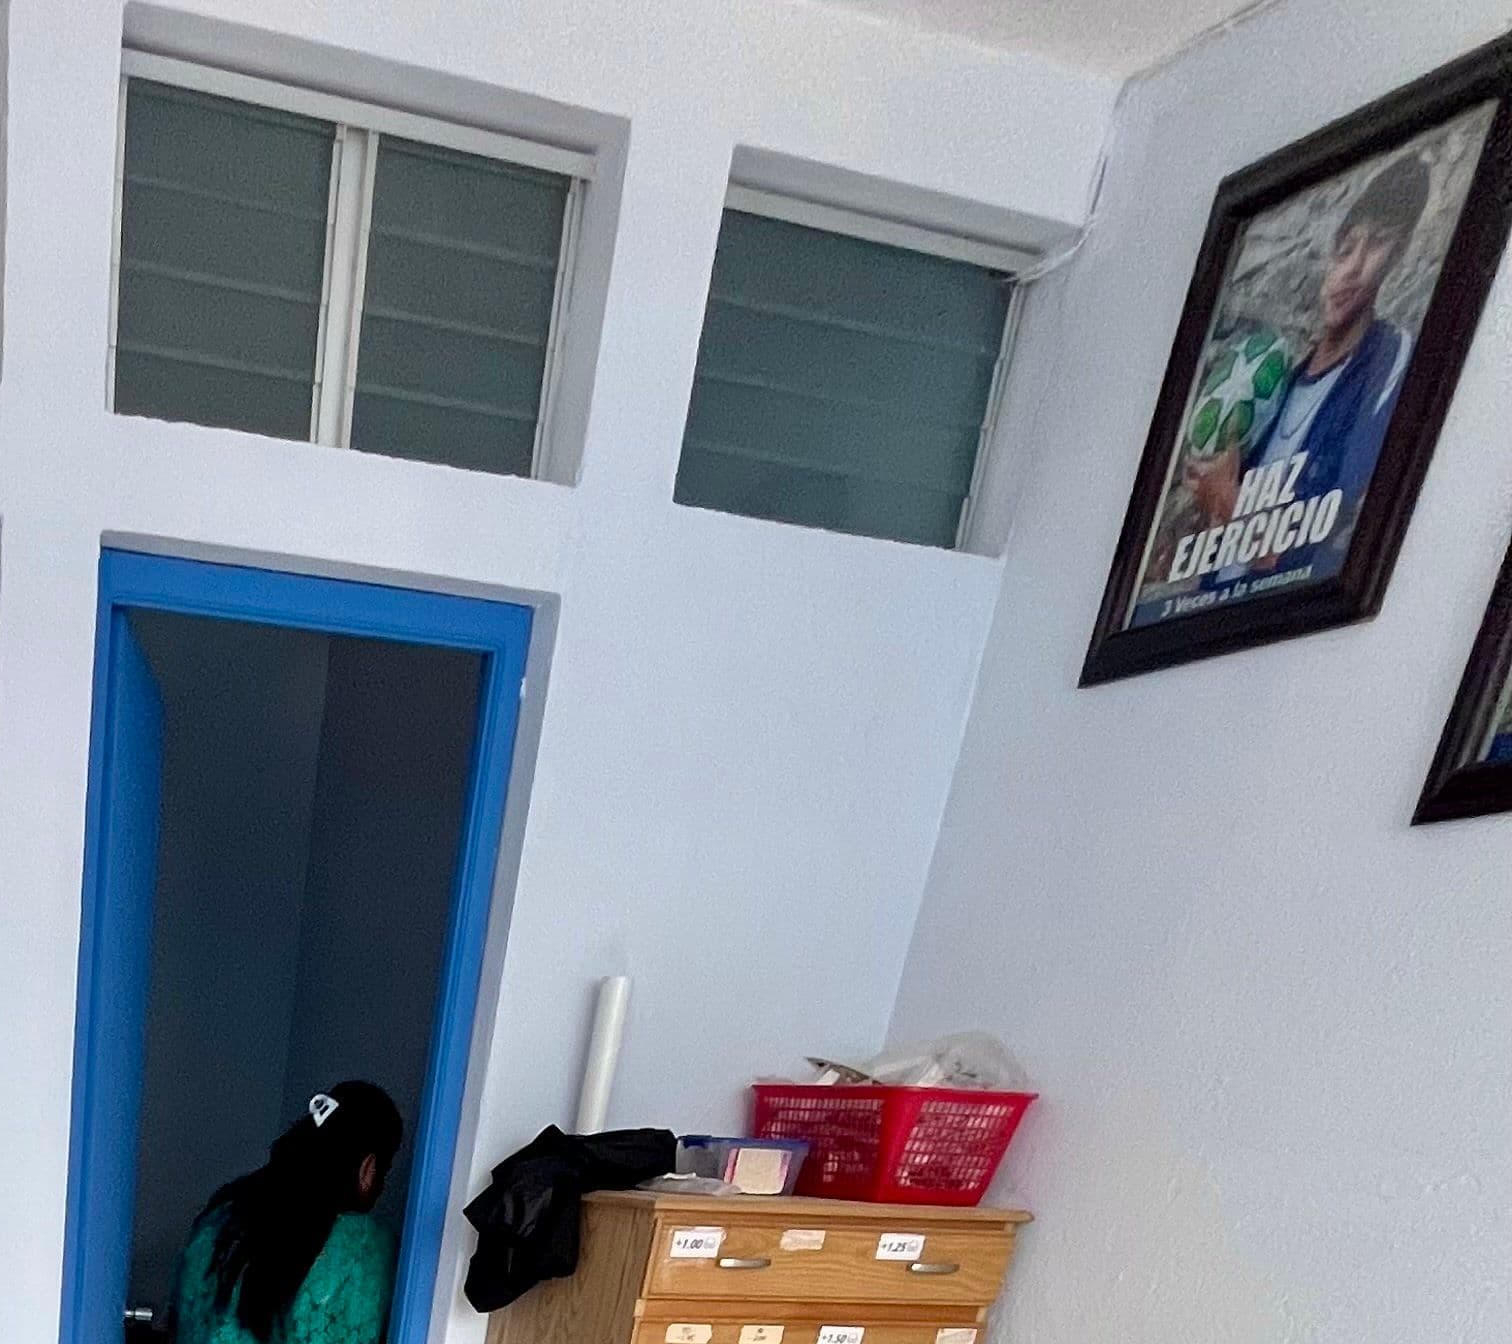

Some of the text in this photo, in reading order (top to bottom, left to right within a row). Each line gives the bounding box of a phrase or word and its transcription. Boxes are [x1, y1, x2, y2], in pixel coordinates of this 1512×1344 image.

[1232, 450, 1309, 519] HAZ
[1167, 489, 1344, 584] EJERCICIO
[1250, 563, 1314, 594] semana
[676, 1238, 705, 1250] +1.00
[881, 1241, 907, 1253] +1.25
